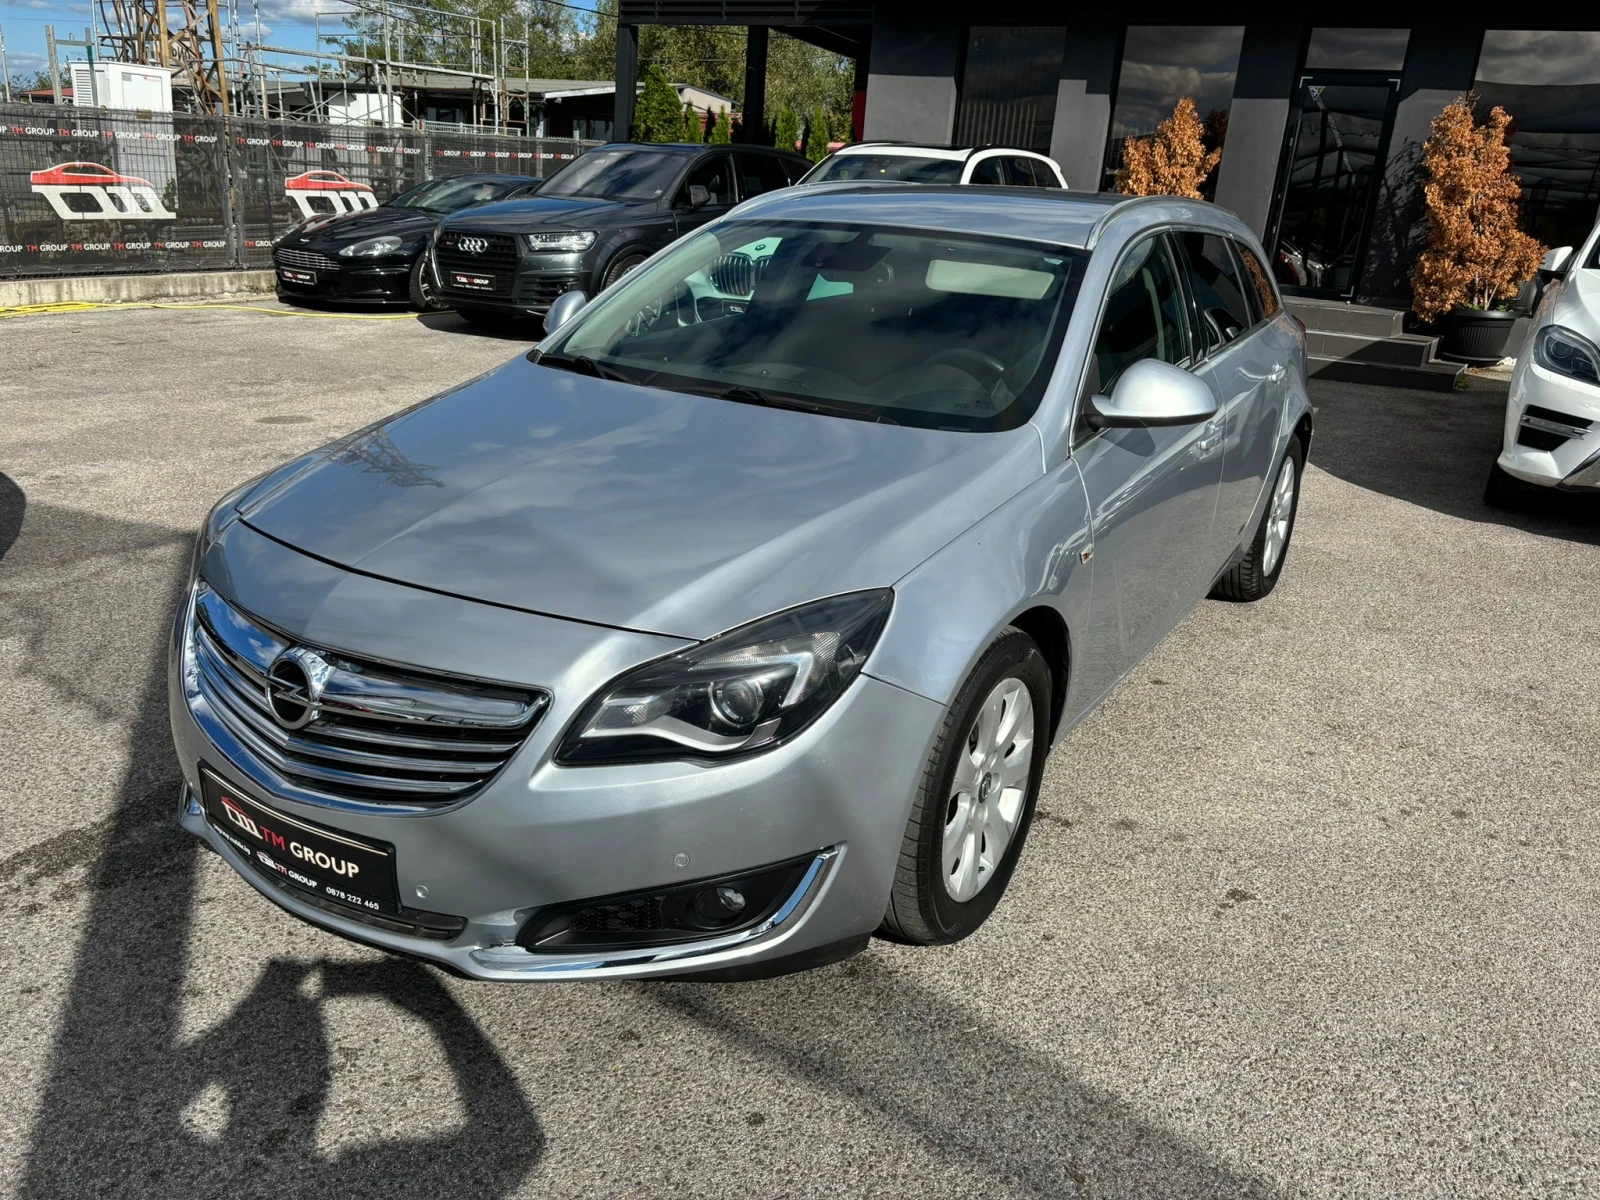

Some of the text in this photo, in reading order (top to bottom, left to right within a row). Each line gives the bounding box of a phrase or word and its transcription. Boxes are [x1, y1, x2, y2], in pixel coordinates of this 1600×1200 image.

[11, 126, 24, 135] TM
[25, 127, 55, 136] GROUP
[57, 128, 70, 137] TM
[71, 129, 99, 138] GROUP
[115, 131, 141, 140] GROUP
[155, 133, 181, 141] GROUP
[183, 134, 194, 142] TM
[194, 135, 218, 143] GROUP
[236, 137, 246, 145] TM
[246, 138, 270, 146] GROUP
[282, 140, 304, 148] GROUP
[26, 244, 38, 252] TM
[40, 244, 68, 252] GROUP
[71, 243, 83, 251] TM
[83, 242, 110, 251] GROUP
[125, 242, 151, 250] GROUP
[165, 241, 190, 249] GROUP
[255, 240, 274, 248] GROU
[260, 825, 360, 878] TM GROUP
[288, 870, 318, 888] GROUP
[325, 886, 346, 899] 0878
[346, 894, 362, 905] 222
